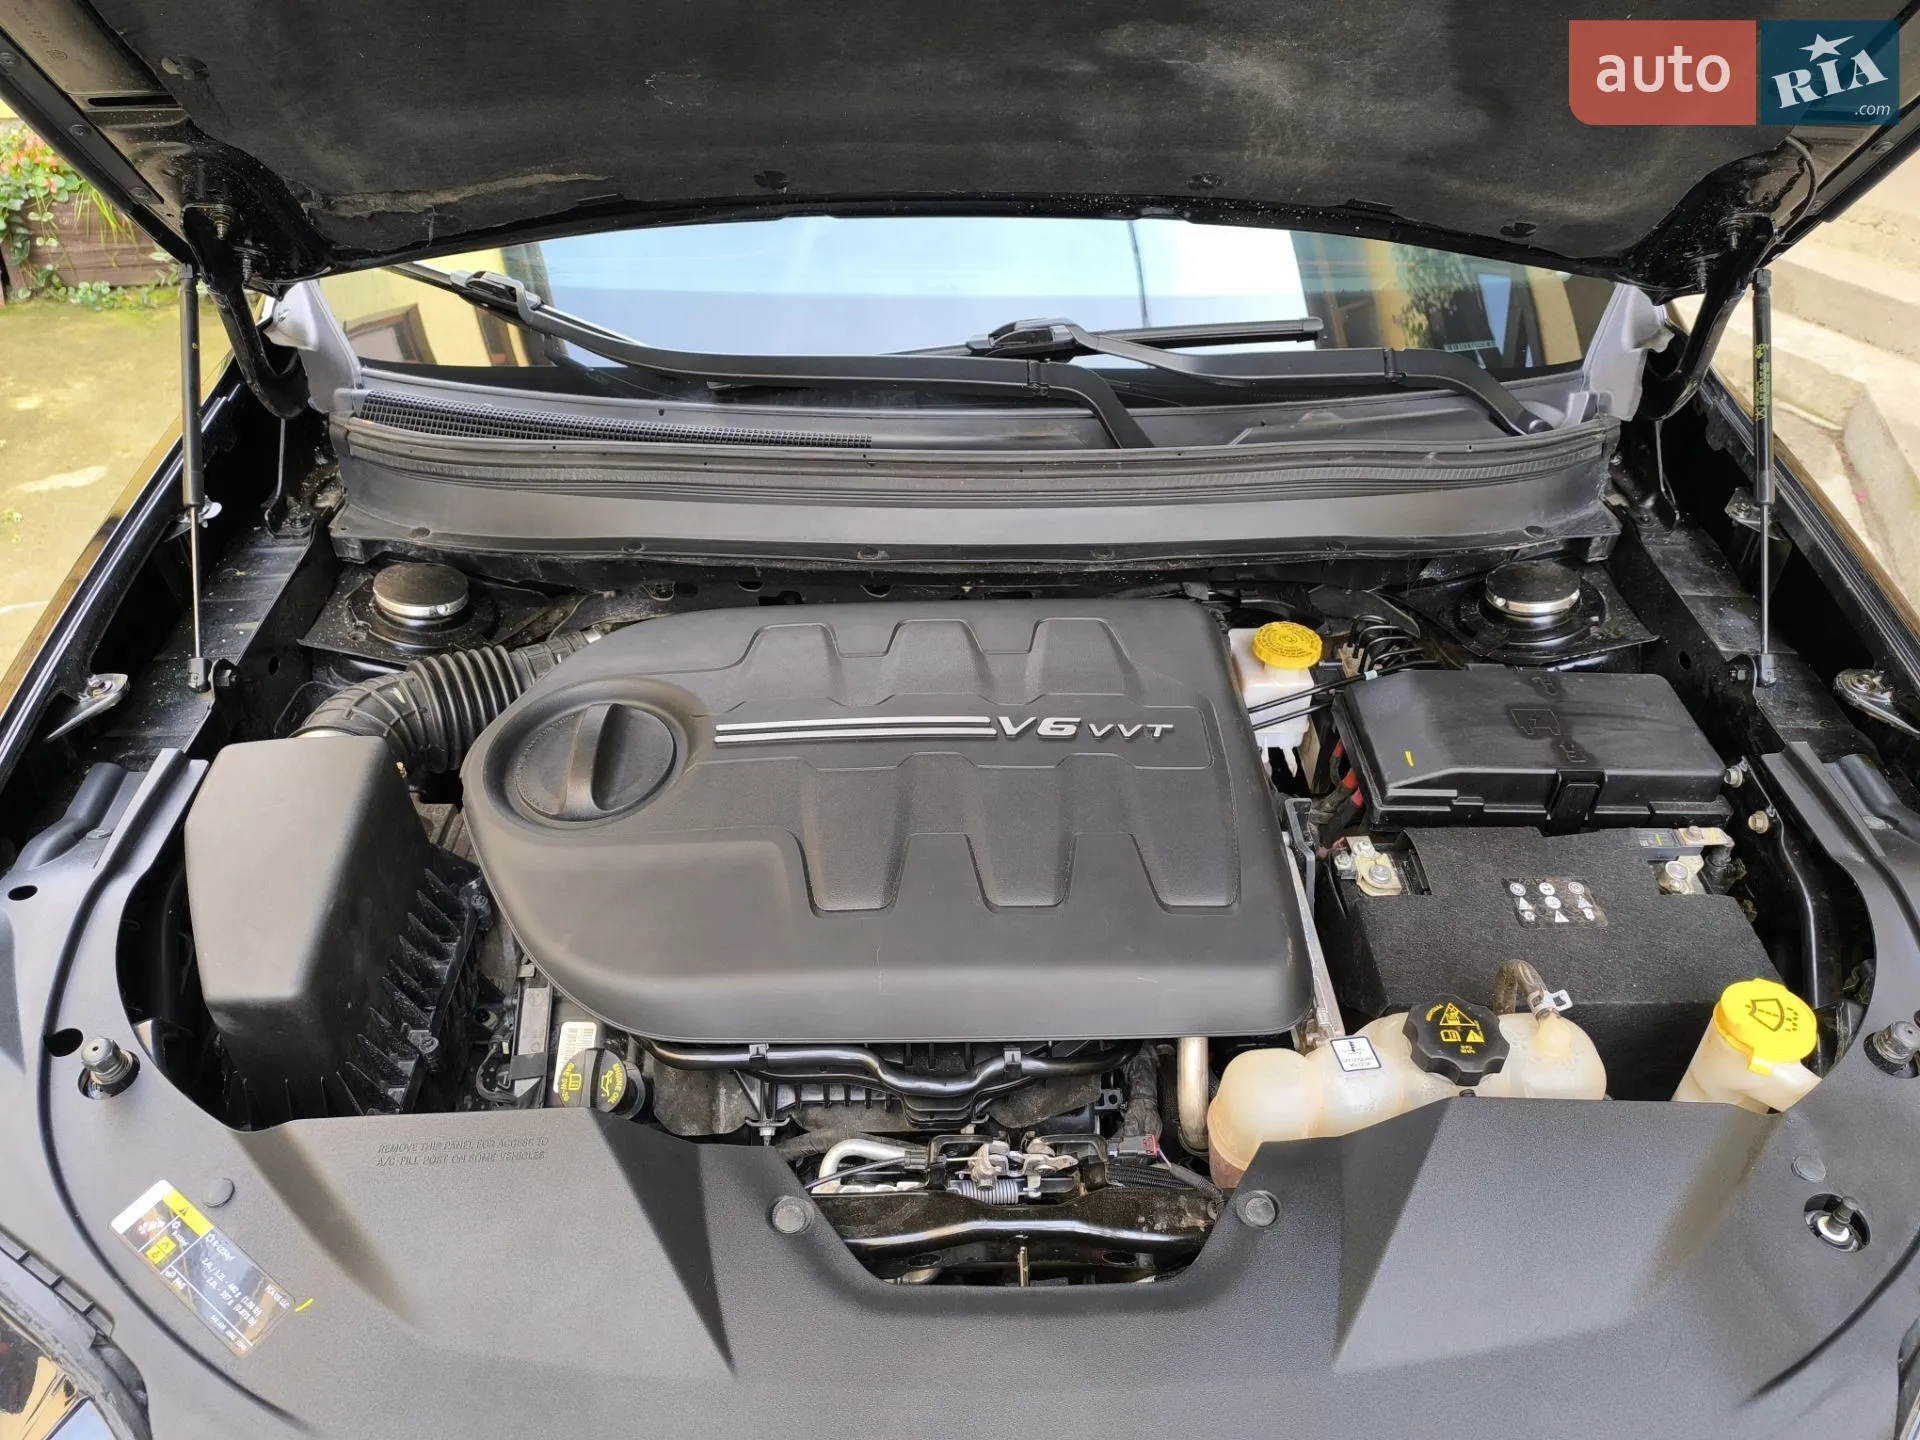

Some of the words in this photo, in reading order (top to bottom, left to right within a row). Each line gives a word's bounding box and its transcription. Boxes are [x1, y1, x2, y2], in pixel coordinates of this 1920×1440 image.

[997, 716, 1081, 738] V6
[1088, 724, 1174, 739] VVT
[612, 1063, 623, 1091] ENGINE
[608, 1091, 619, 1104] OIL
[377, 1143, 418, 1154] REMOVE
[444, 1140, 474, 1151] PANEL
[476, 1139, 496, 1150] FOR
[498, 1137, 534, 1149] ACCESS
[537, 1136, 549, 1146] TO
[376, 1156, 395, 1167] A/C
[452, 1153, 466, 1164] ON
[499, 1150, 545, 1161] VEHICLES
